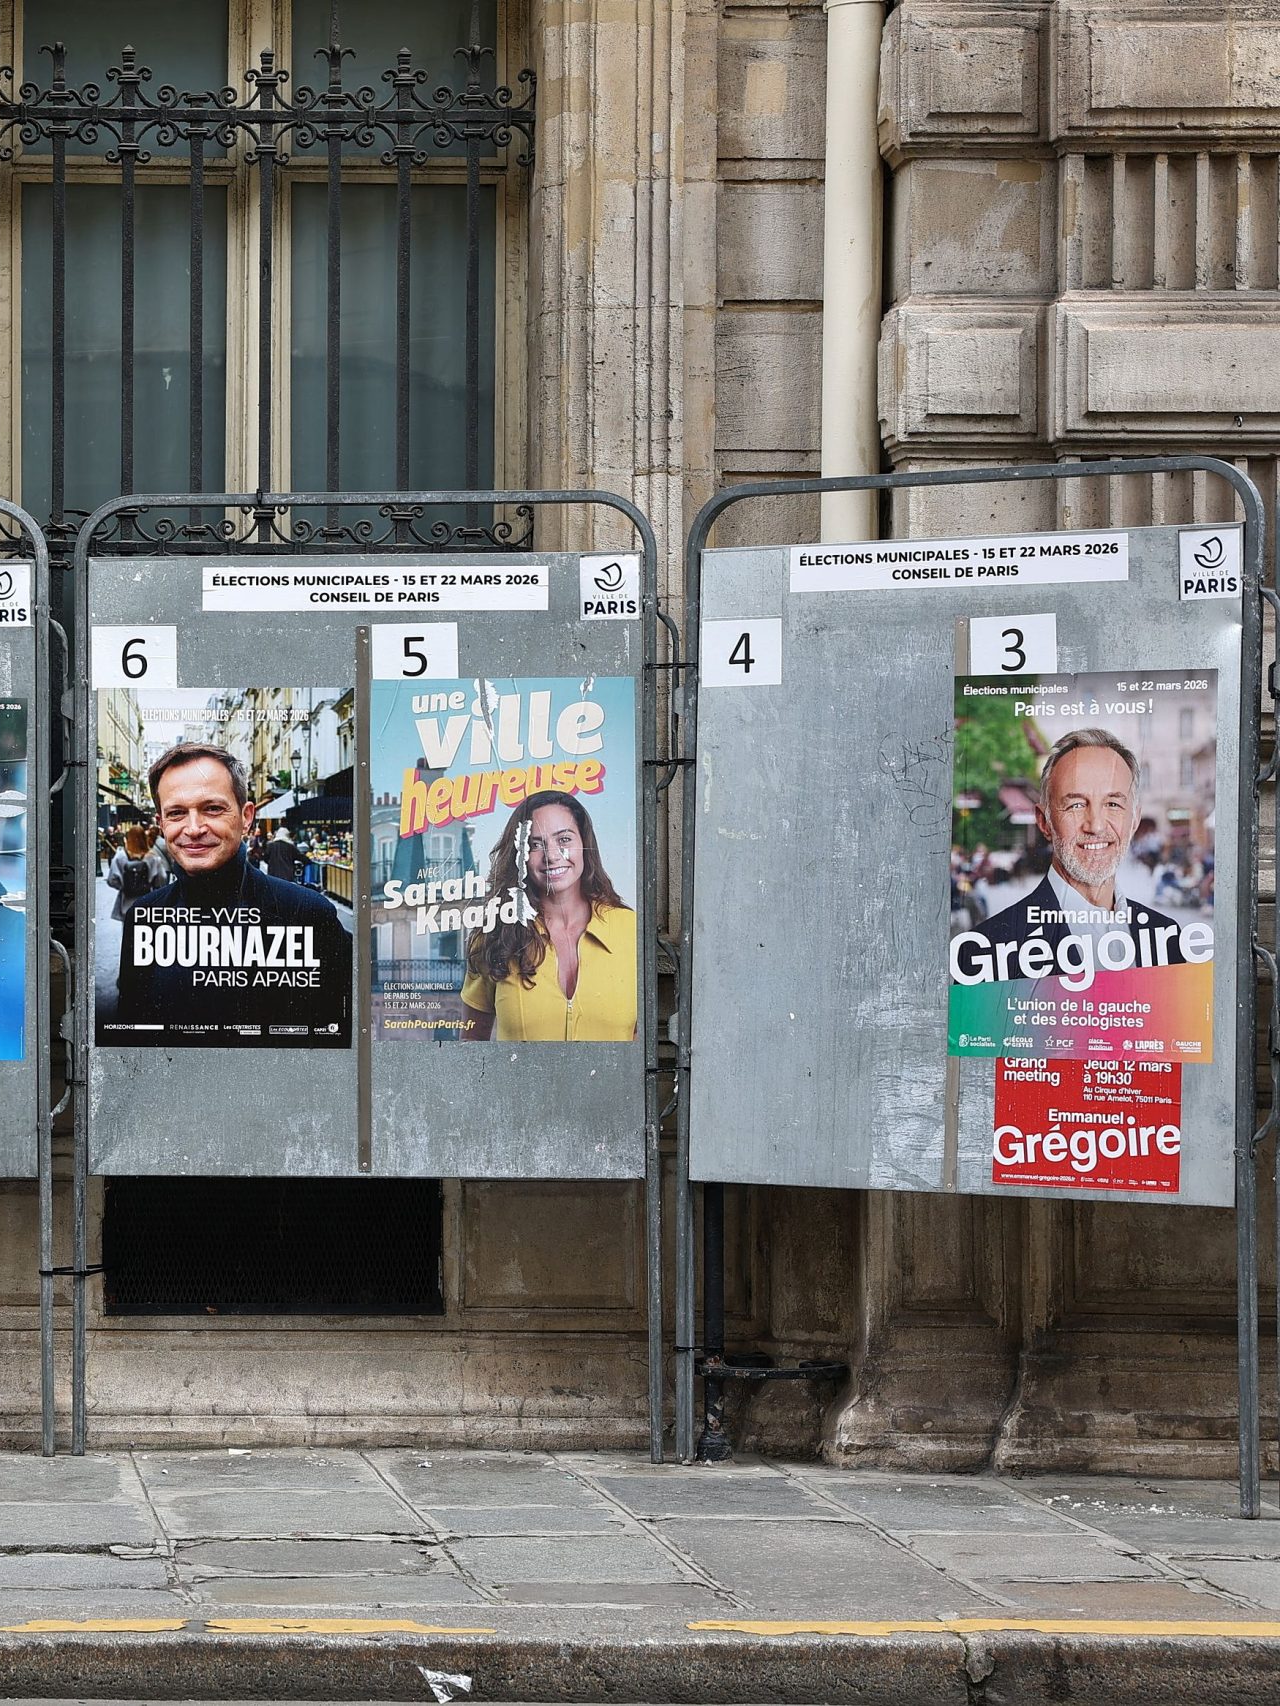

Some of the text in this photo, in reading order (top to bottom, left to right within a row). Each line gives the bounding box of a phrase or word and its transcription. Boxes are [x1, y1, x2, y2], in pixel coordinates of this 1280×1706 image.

[799, 542, 1119, 567] ÉLECTIONS MUNICIPALES 15 ET 22 MARS 2026
[212, 573, 539, 586] ÉLECTIONS MUNICIPALES 15 ET 22 MARS 2026
[891, 564, 1019, 581] CONSEIL DE PARIS
[1184, 576, 1238, 594] PARIS
[309, 592, 440, 603] CONSEIL DE PARIS
[584, 600, 637, 614] PARIS
[402, 636, 428, 677] 5
[728, 632, 755, 674] 4
[1001, 628, 1027, 671] 3
[121, 638, 148, 679] 6
[963, 684, 1069, 696] Élections municipales
[1116, 680, 1208, 692] 15 et 22 mars 2026
[411, 690, 466, 714] une
[1014, 700, 1055, 717] Paris
[1060, 702, 1086, 715] est
[1088, 699, 1100, 715] à
[180, 709, 229, 721] MUNICIPALES
[237, 709, 244, 721] 15
[246, 709, 255, 721] ET
[256, 709, 266, 721] 22
[266, 709, 289, 721] MARS
[289, 709, 309, 721] 2026
[414, 690, 606, 769] ville
[399, 758, 606, 839] heureuse
[416, 866, 439, 880] AVEC
[383, 870, 486, 909] Sarah
[134, 907, 261, 924] PIERRE-YVES
[1026, 905, 1132, 925] Emmanuel
[133, 925, 320, 967] BOURNAZEL
[949, 911, 1215, 992] Grégoire
[192, 967, 321, 987] PARIS APAISÉ
[383, 981, 453, 991] ÉLECTIONS MUNICIPALES
[1007, 997, 1151, 1017] L'union de la gauche
[383, 1019, 476, 1031] SarahPourParis.fr
[1014, 1013, 1144, 1030] et des écologistes
[1056, 1039, 1074, 1048] PCF
[1004, 1057, 1047, 1069] Grand
[1083, 1060, 1172, 1073] Jeudi 12 mars
[1004, 1068, 1061, 1087] meeting
[1083, 1071, 1132, 1085] à 19h30
[1083, 1086, 1093, 1094] Au
[1094, 1086, 1117, 1095] Cirque
[1107, 1095, 1134, 1103] Amelot,
[1154, 1096, 1173, 1104] Paris
[1048, 1108, 1124, 1125] Emmanuel
[993, 1115, 1182, 1173] Grégoire
